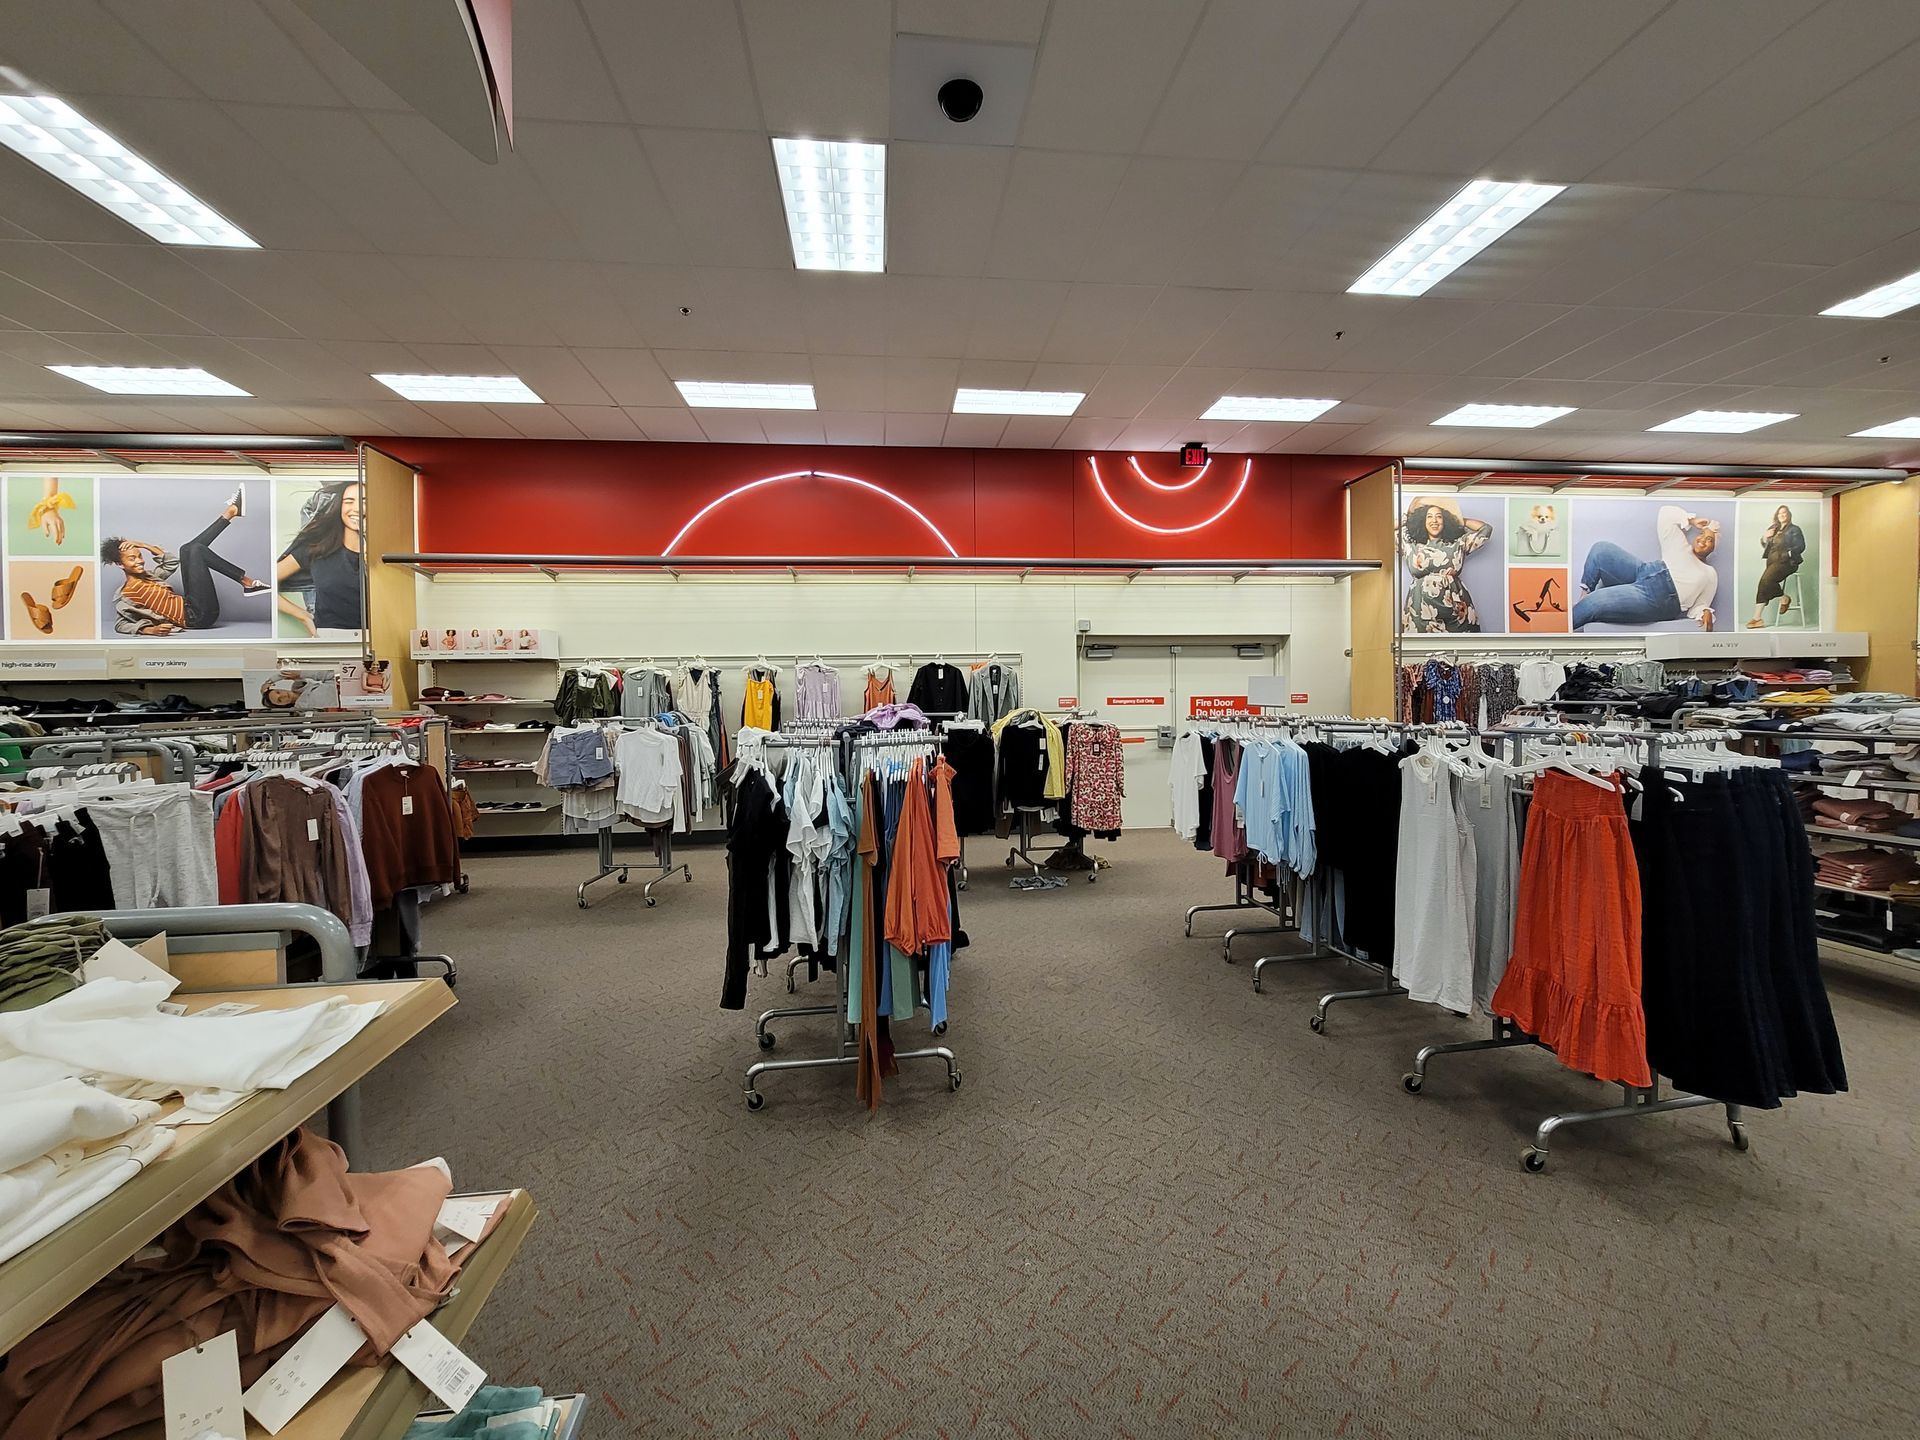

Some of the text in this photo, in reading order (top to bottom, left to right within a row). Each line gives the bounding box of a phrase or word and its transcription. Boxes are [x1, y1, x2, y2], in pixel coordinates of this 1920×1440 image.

[1185, 449, 1205, 465] EXIT
[1, 661, 57, 669] high-rise skinny
[342, 666, 357, 678] $7
[1195, 698, 1235, 707] Fire Door
[1195, 708, 1250, 717] Do Not Block
